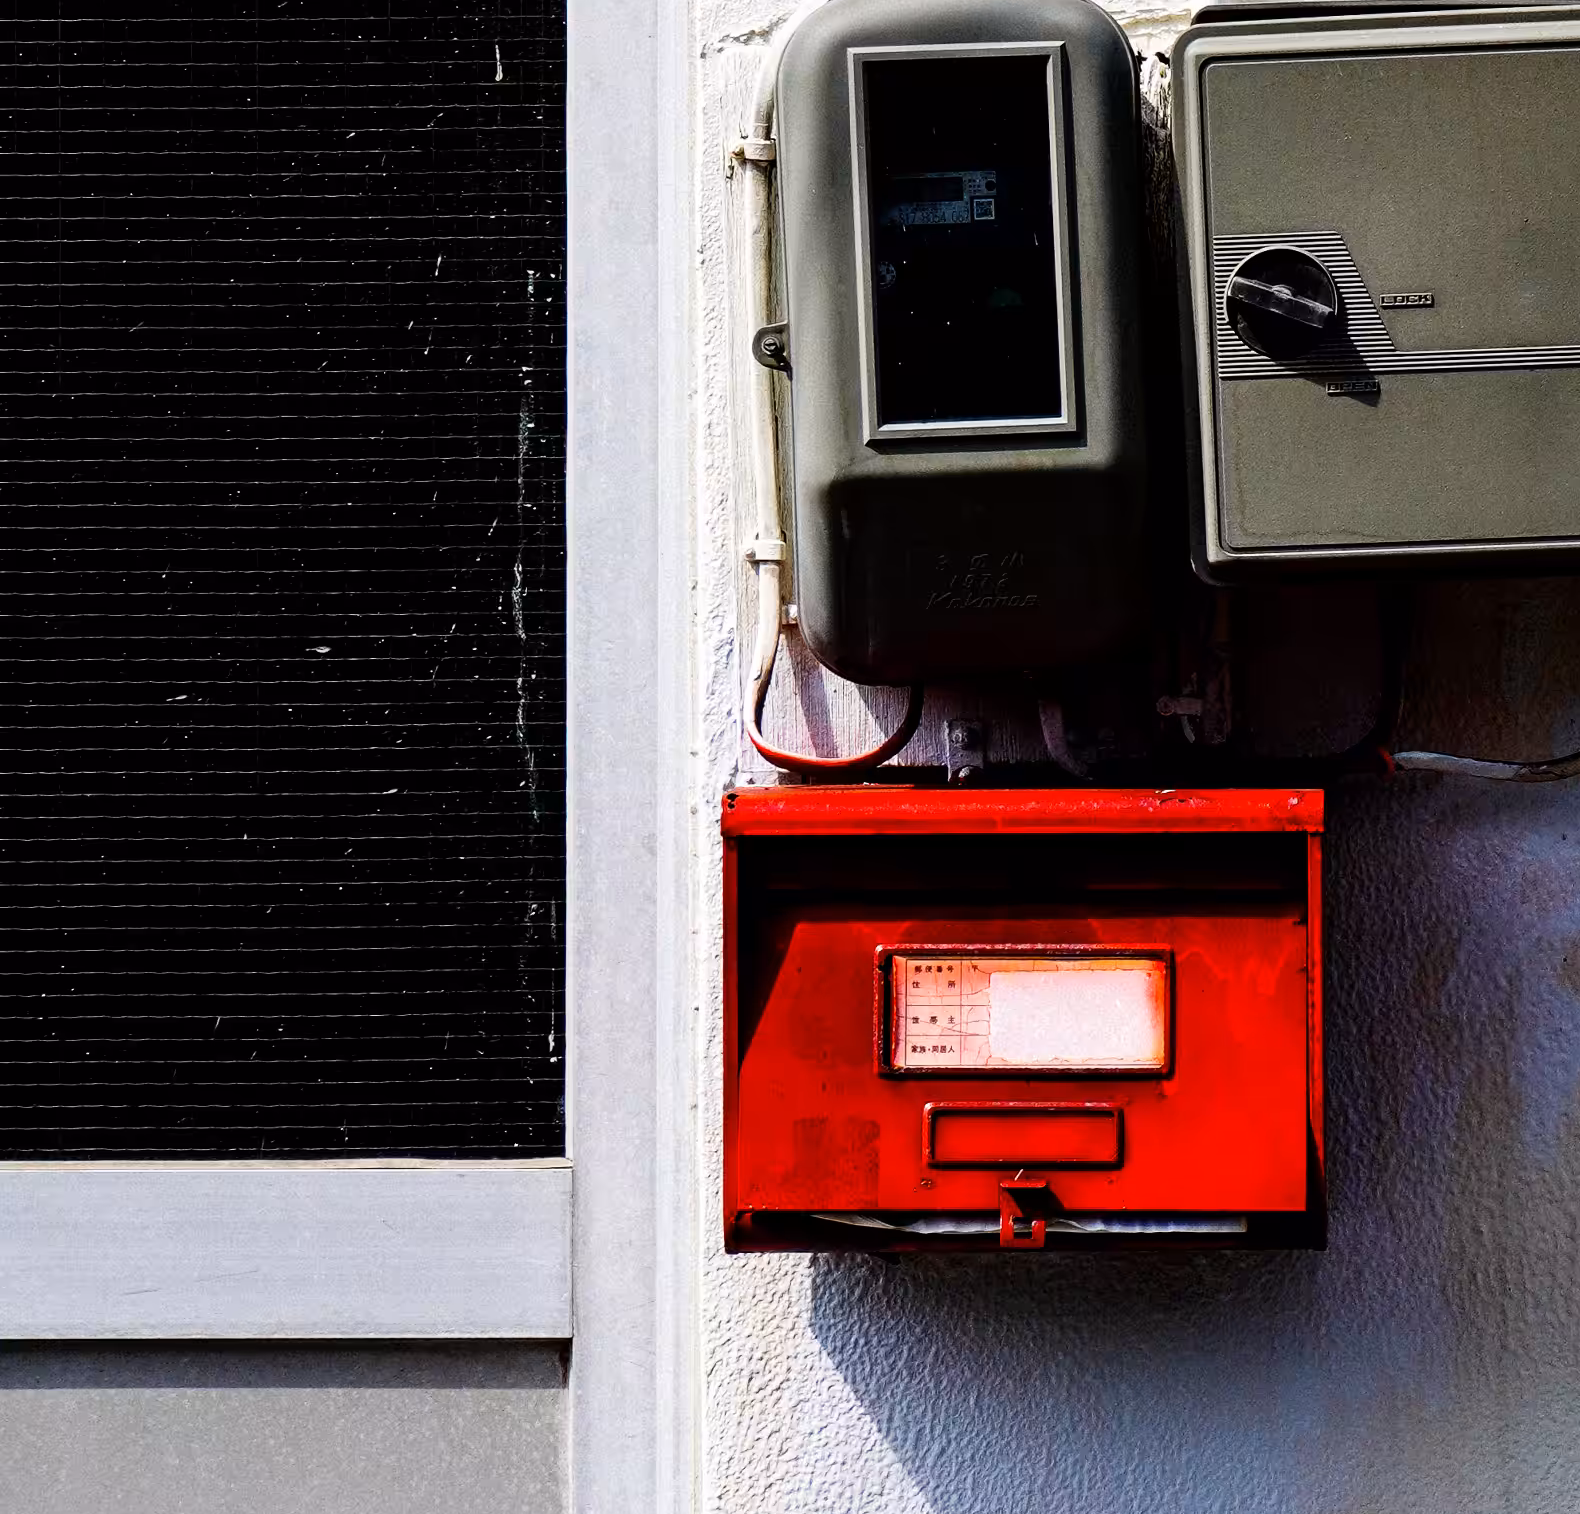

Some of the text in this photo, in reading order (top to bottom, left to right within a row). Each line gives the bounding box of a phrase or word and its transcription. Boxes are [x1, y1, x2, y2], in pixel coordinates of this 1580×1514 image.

[1381, 293, 1433, 307] LOCK
[1326, 380, 1379, 394] OPEN
[914, 965, 954, 973] 郵便番号
